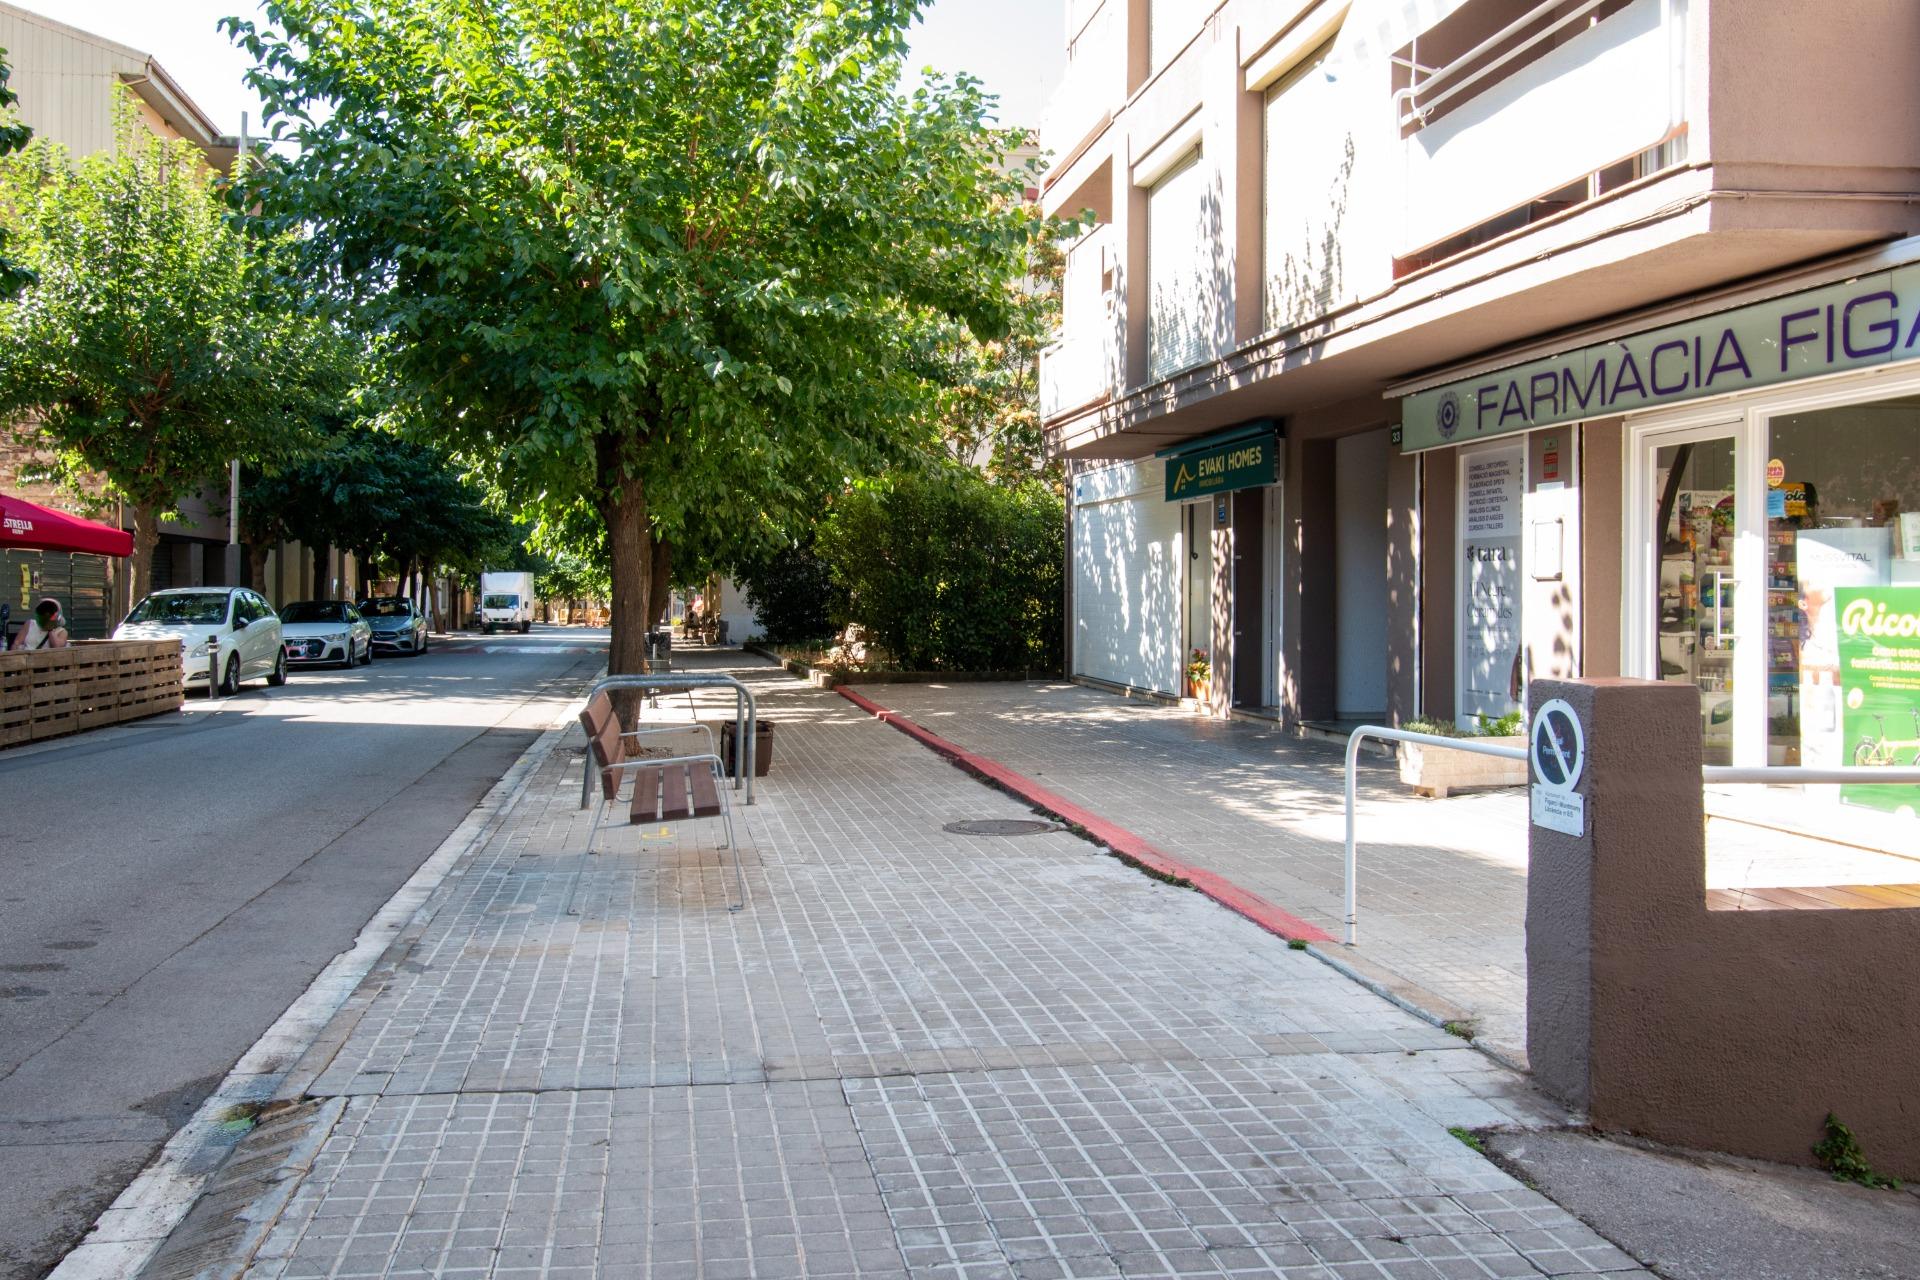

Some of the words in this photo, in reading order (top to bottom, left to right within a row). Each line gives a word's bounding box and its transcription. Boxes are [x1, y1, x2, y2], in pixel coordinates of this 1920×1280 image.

[1477, 328, 1752, 430] FARMÀCIA
[1392, 432, 1400, 443] 33
[1199, 455, 1225, 477] EVAKI
[1228, 446, 1262, 471] HOMES
[4, 518, 33, 531] STRELLA
[1477, 545, 1506, 561] tara
[1842, 598, 1920, 637] Rico
